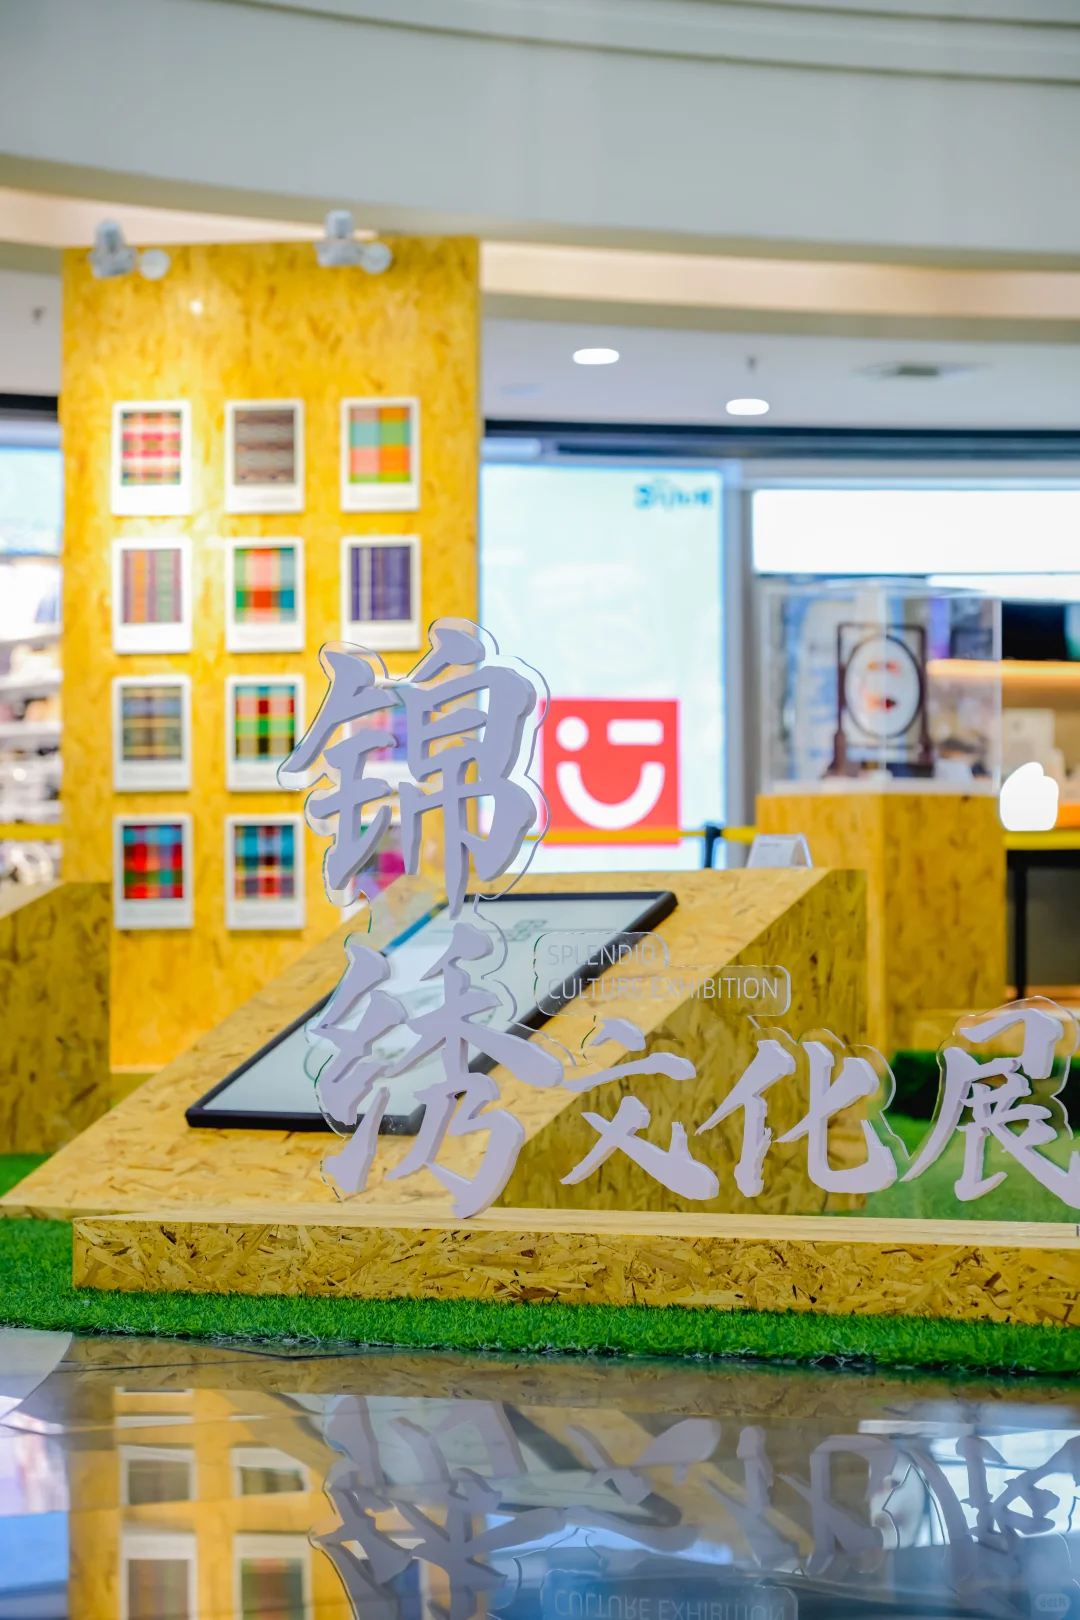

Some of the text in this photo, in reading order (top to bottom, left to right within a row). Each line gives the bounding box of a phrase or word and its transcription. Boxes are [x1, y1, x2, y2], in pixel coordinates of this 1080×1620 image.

[283, 628, 564, 1219] 锦绣
[547, 944, 655, 966] SPLENDID
[548, 977, 778, 1000] CULTURE EXHIBITION
[561, 1008, 1080, 1210] 文化展
